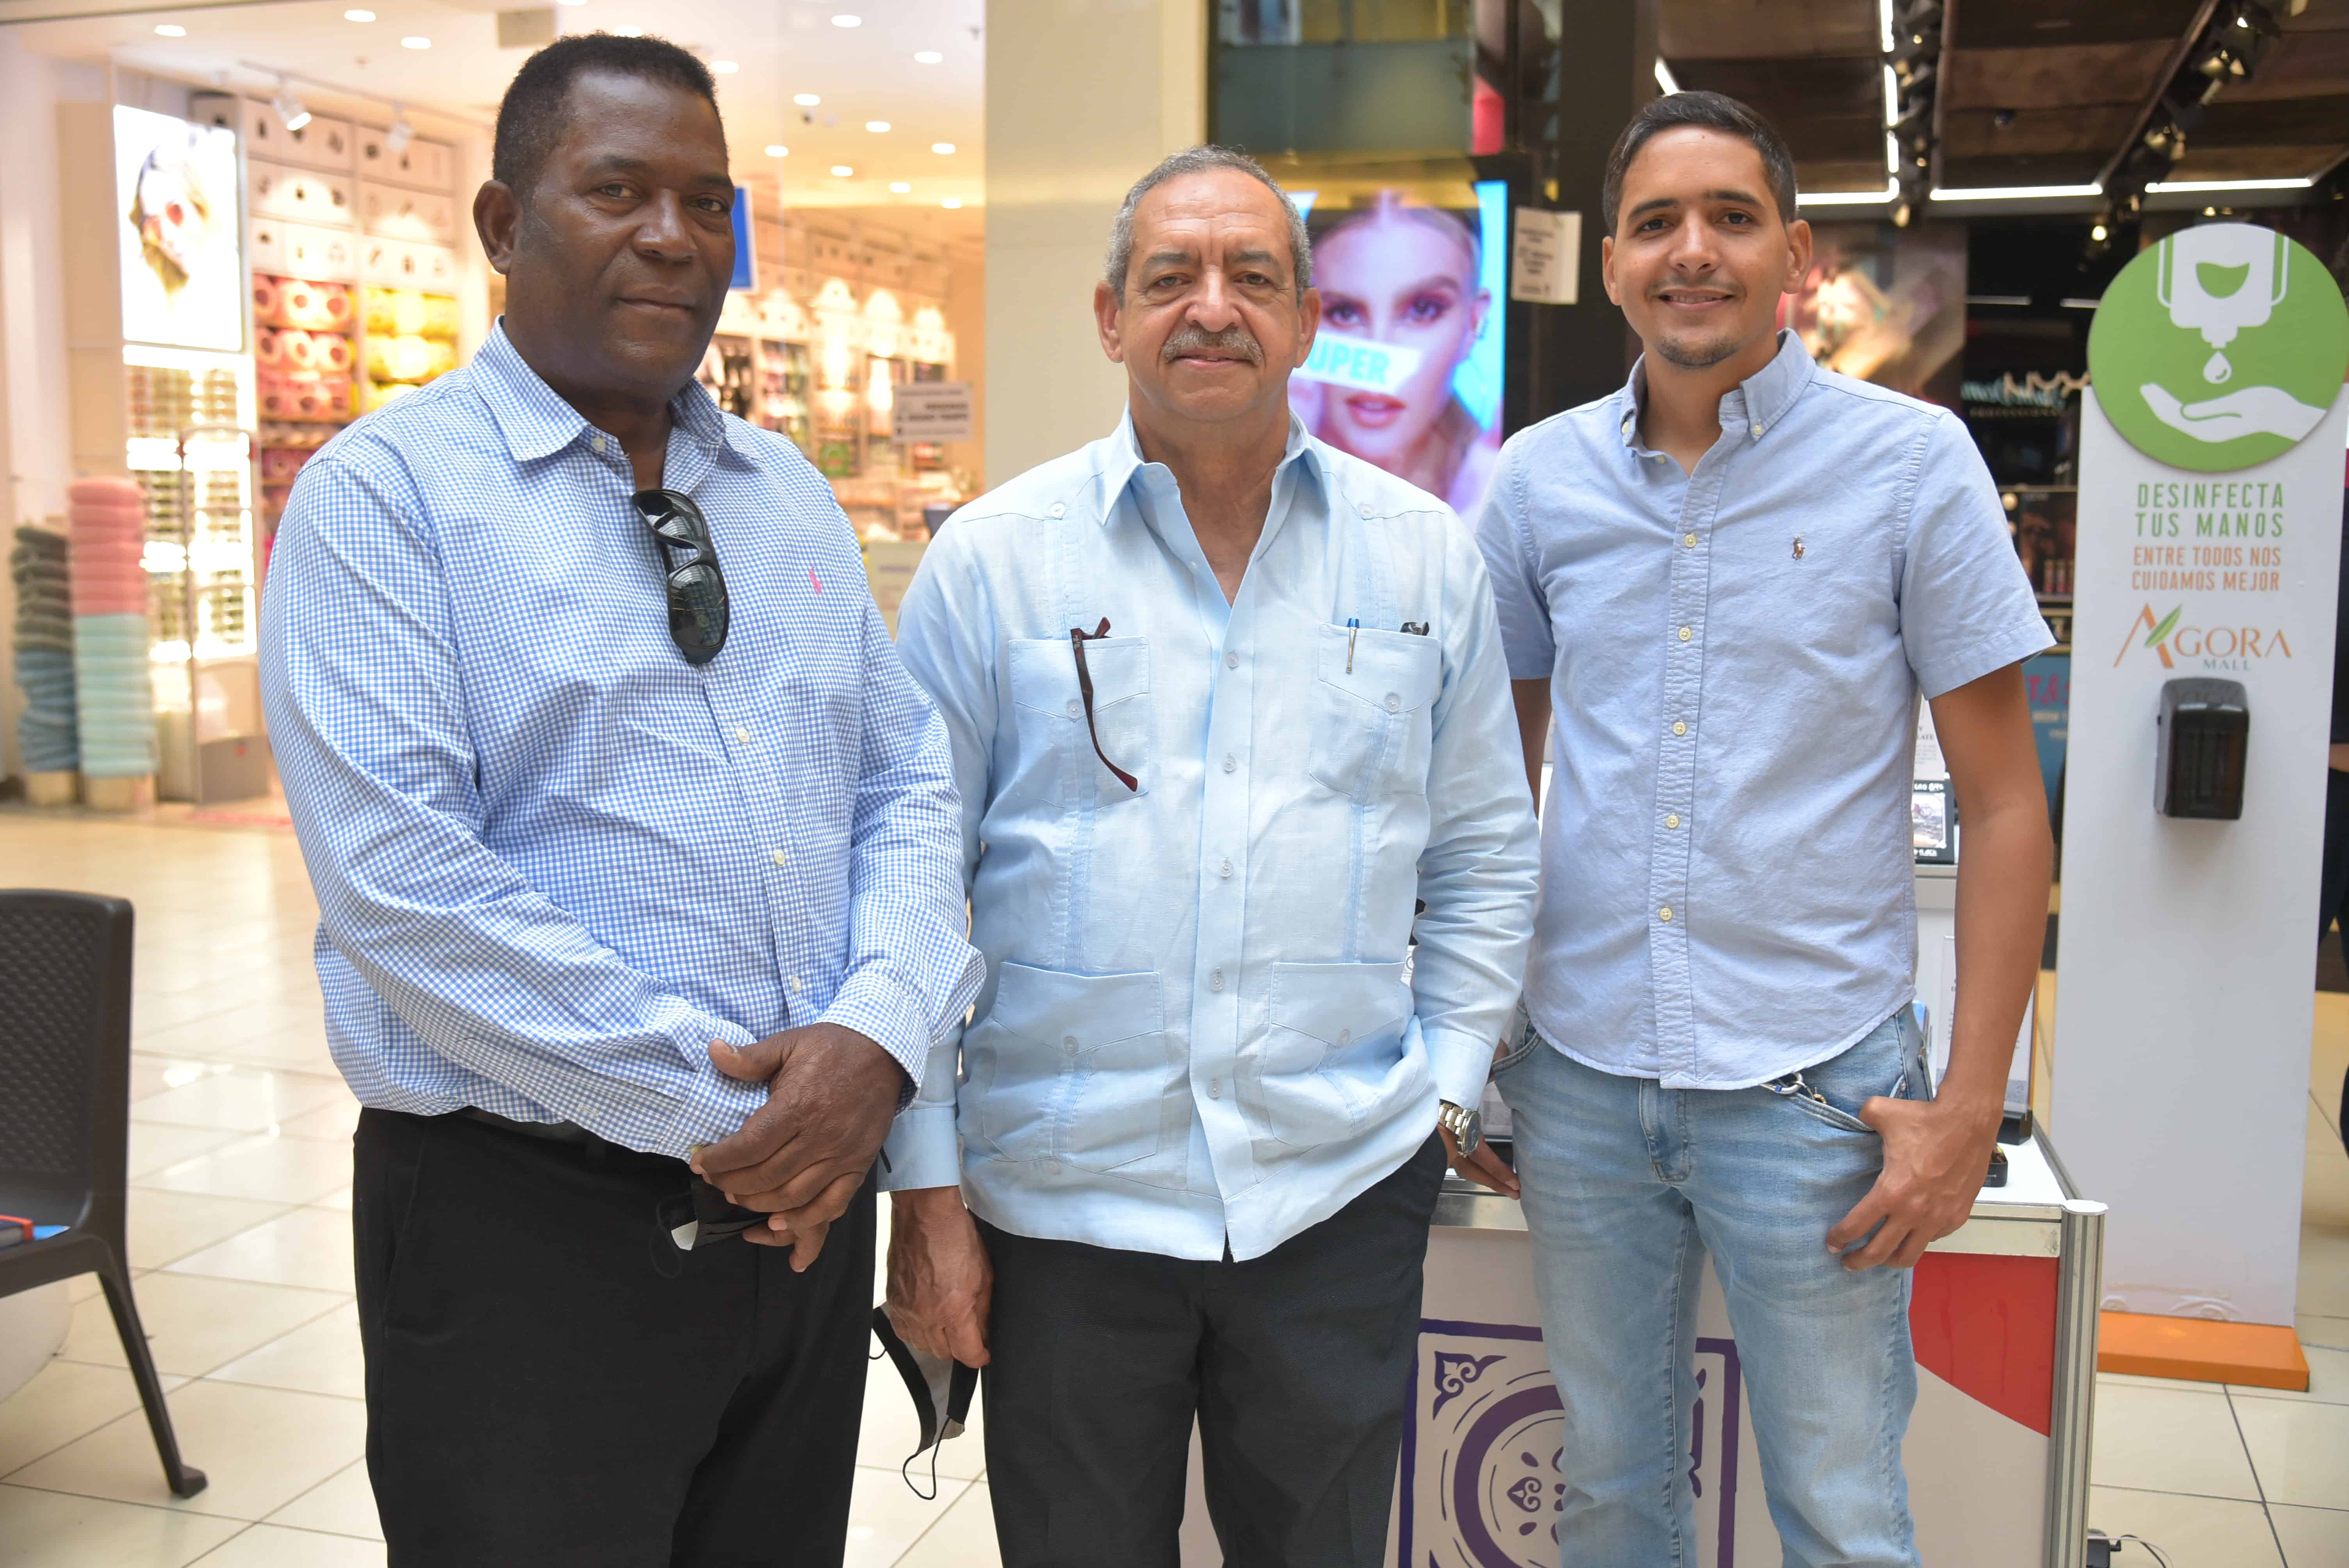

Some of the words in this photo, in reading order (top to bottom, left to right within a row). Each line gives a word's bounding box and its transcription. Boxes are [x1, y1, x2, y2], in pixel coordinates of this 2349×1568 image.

[1307, 337, 1389, 385] UPER
[2137, 482, 2284, 508] DESINFECTA
[2135, 512, 2180, 538] TUS
[2196, 512, 2283, 538] MANOS
[2133, 545, 2186, 566] ENTRE
[2193, 545, 2243, 567] TODOS
[2249, 546, 2281, 567] NOS
[2132, 570, 2215, 591] CUIDAMOS
[2223, 570, 2281, 591] MEJOR
[2202, 659, 2251, 671] MALL
